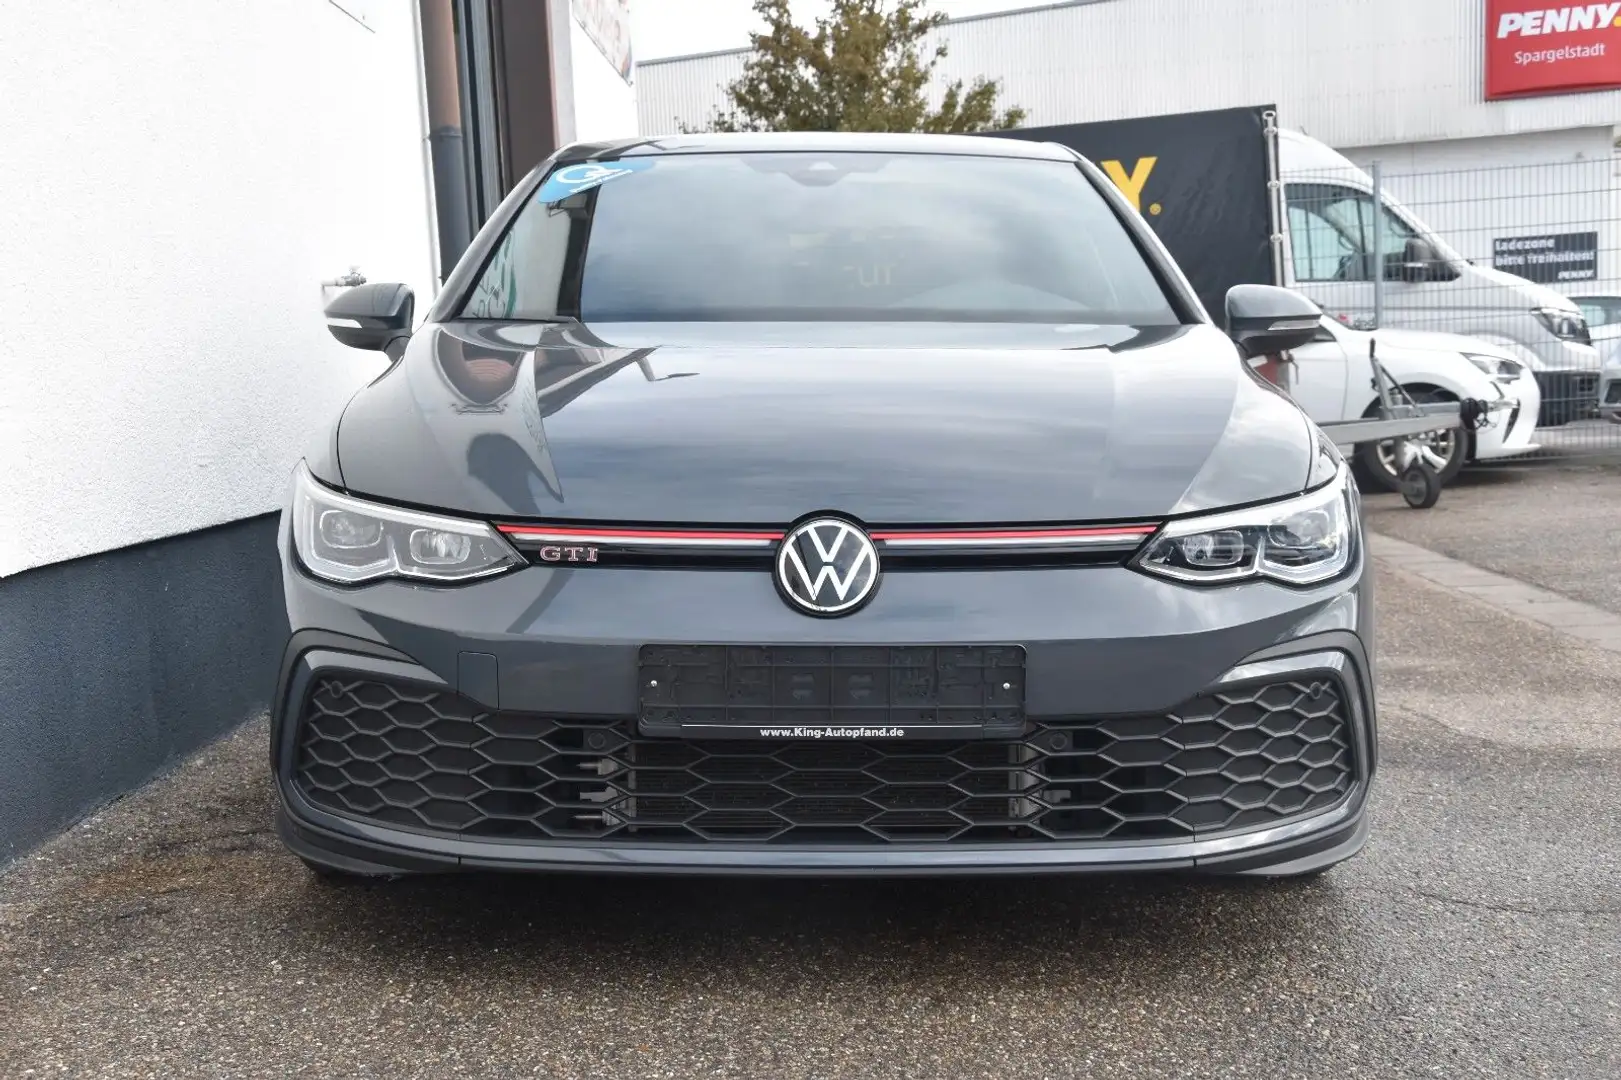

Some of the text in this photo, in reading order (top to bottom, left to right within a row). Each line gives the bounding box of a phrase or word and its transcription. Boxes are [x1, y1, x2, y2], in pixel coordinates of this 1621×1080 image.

[1513, 42, 1606, 66] Spargelstadt
[1495, 239, 1555, 251] Ladezone
[540, 546, 598, 562] GTI
[760, 727, 904, 738] www.King-Autopfand.de
